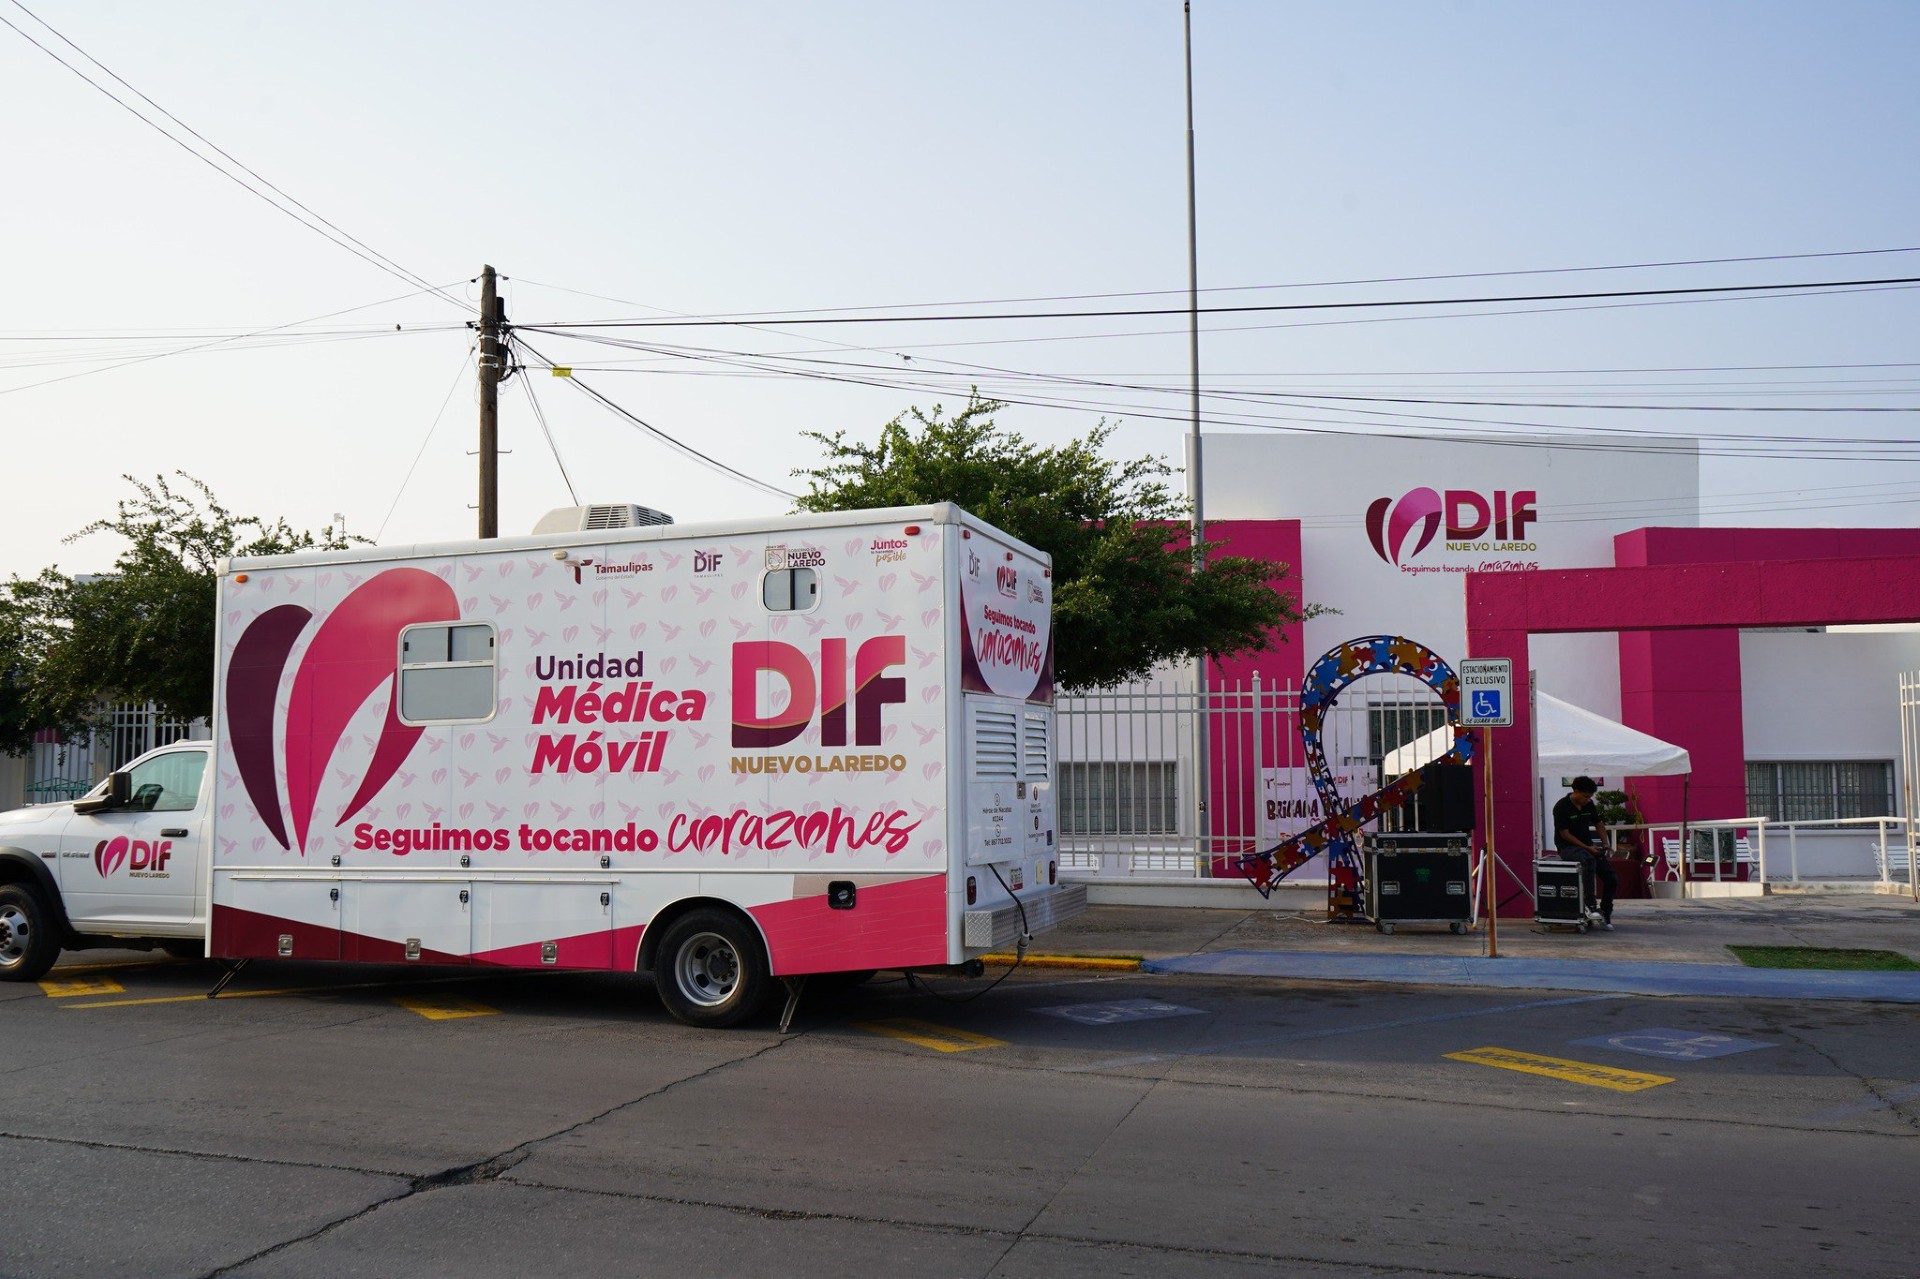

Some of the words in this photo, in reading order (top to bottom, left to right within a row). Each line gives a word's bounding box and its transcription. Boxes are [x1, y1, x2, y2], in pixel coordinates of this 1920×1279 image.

[1445, 490, 1537, 540] DIF
[870, 539, 908, 550] Juntos
[1446, 542, 1489, 551] NUEVO
[1493, 542, 1537, 551] LAREDO
[787, 551, 822, 560] NUEVO
[787, 558, 826, 568] LAREDO
[876, 550, 907, 567] posible
[594, 561, 653, 574] Tamaulipas
[1401, 563, 1441, 576] Seguimos
[1443, 564, 1475, 573] tocando
[984, 604, 1013, 628] Seguimos
[1014, 614, 1036, 635] tocando
[535, 650, 644, 681] Unidad
[1463, 665, 1508, 674] ESTACIONAMIENTO
[1465, 675, 1506, 685] EXCLUSIVO
[731, 635, 906, 748] DIF
[531, 681, 707, 725] Médica
[530, 730, 669, 774] Móvil
[731, 755, 812, 774] NUEVO
[815, 754, 907, 773] LAREDO
[353, 822, 510, 856] Seguimos
[518, 822, 659, 852] tocando
[667, 807, 922, 855] corazones
[129, 840, 173, 871] DIF
